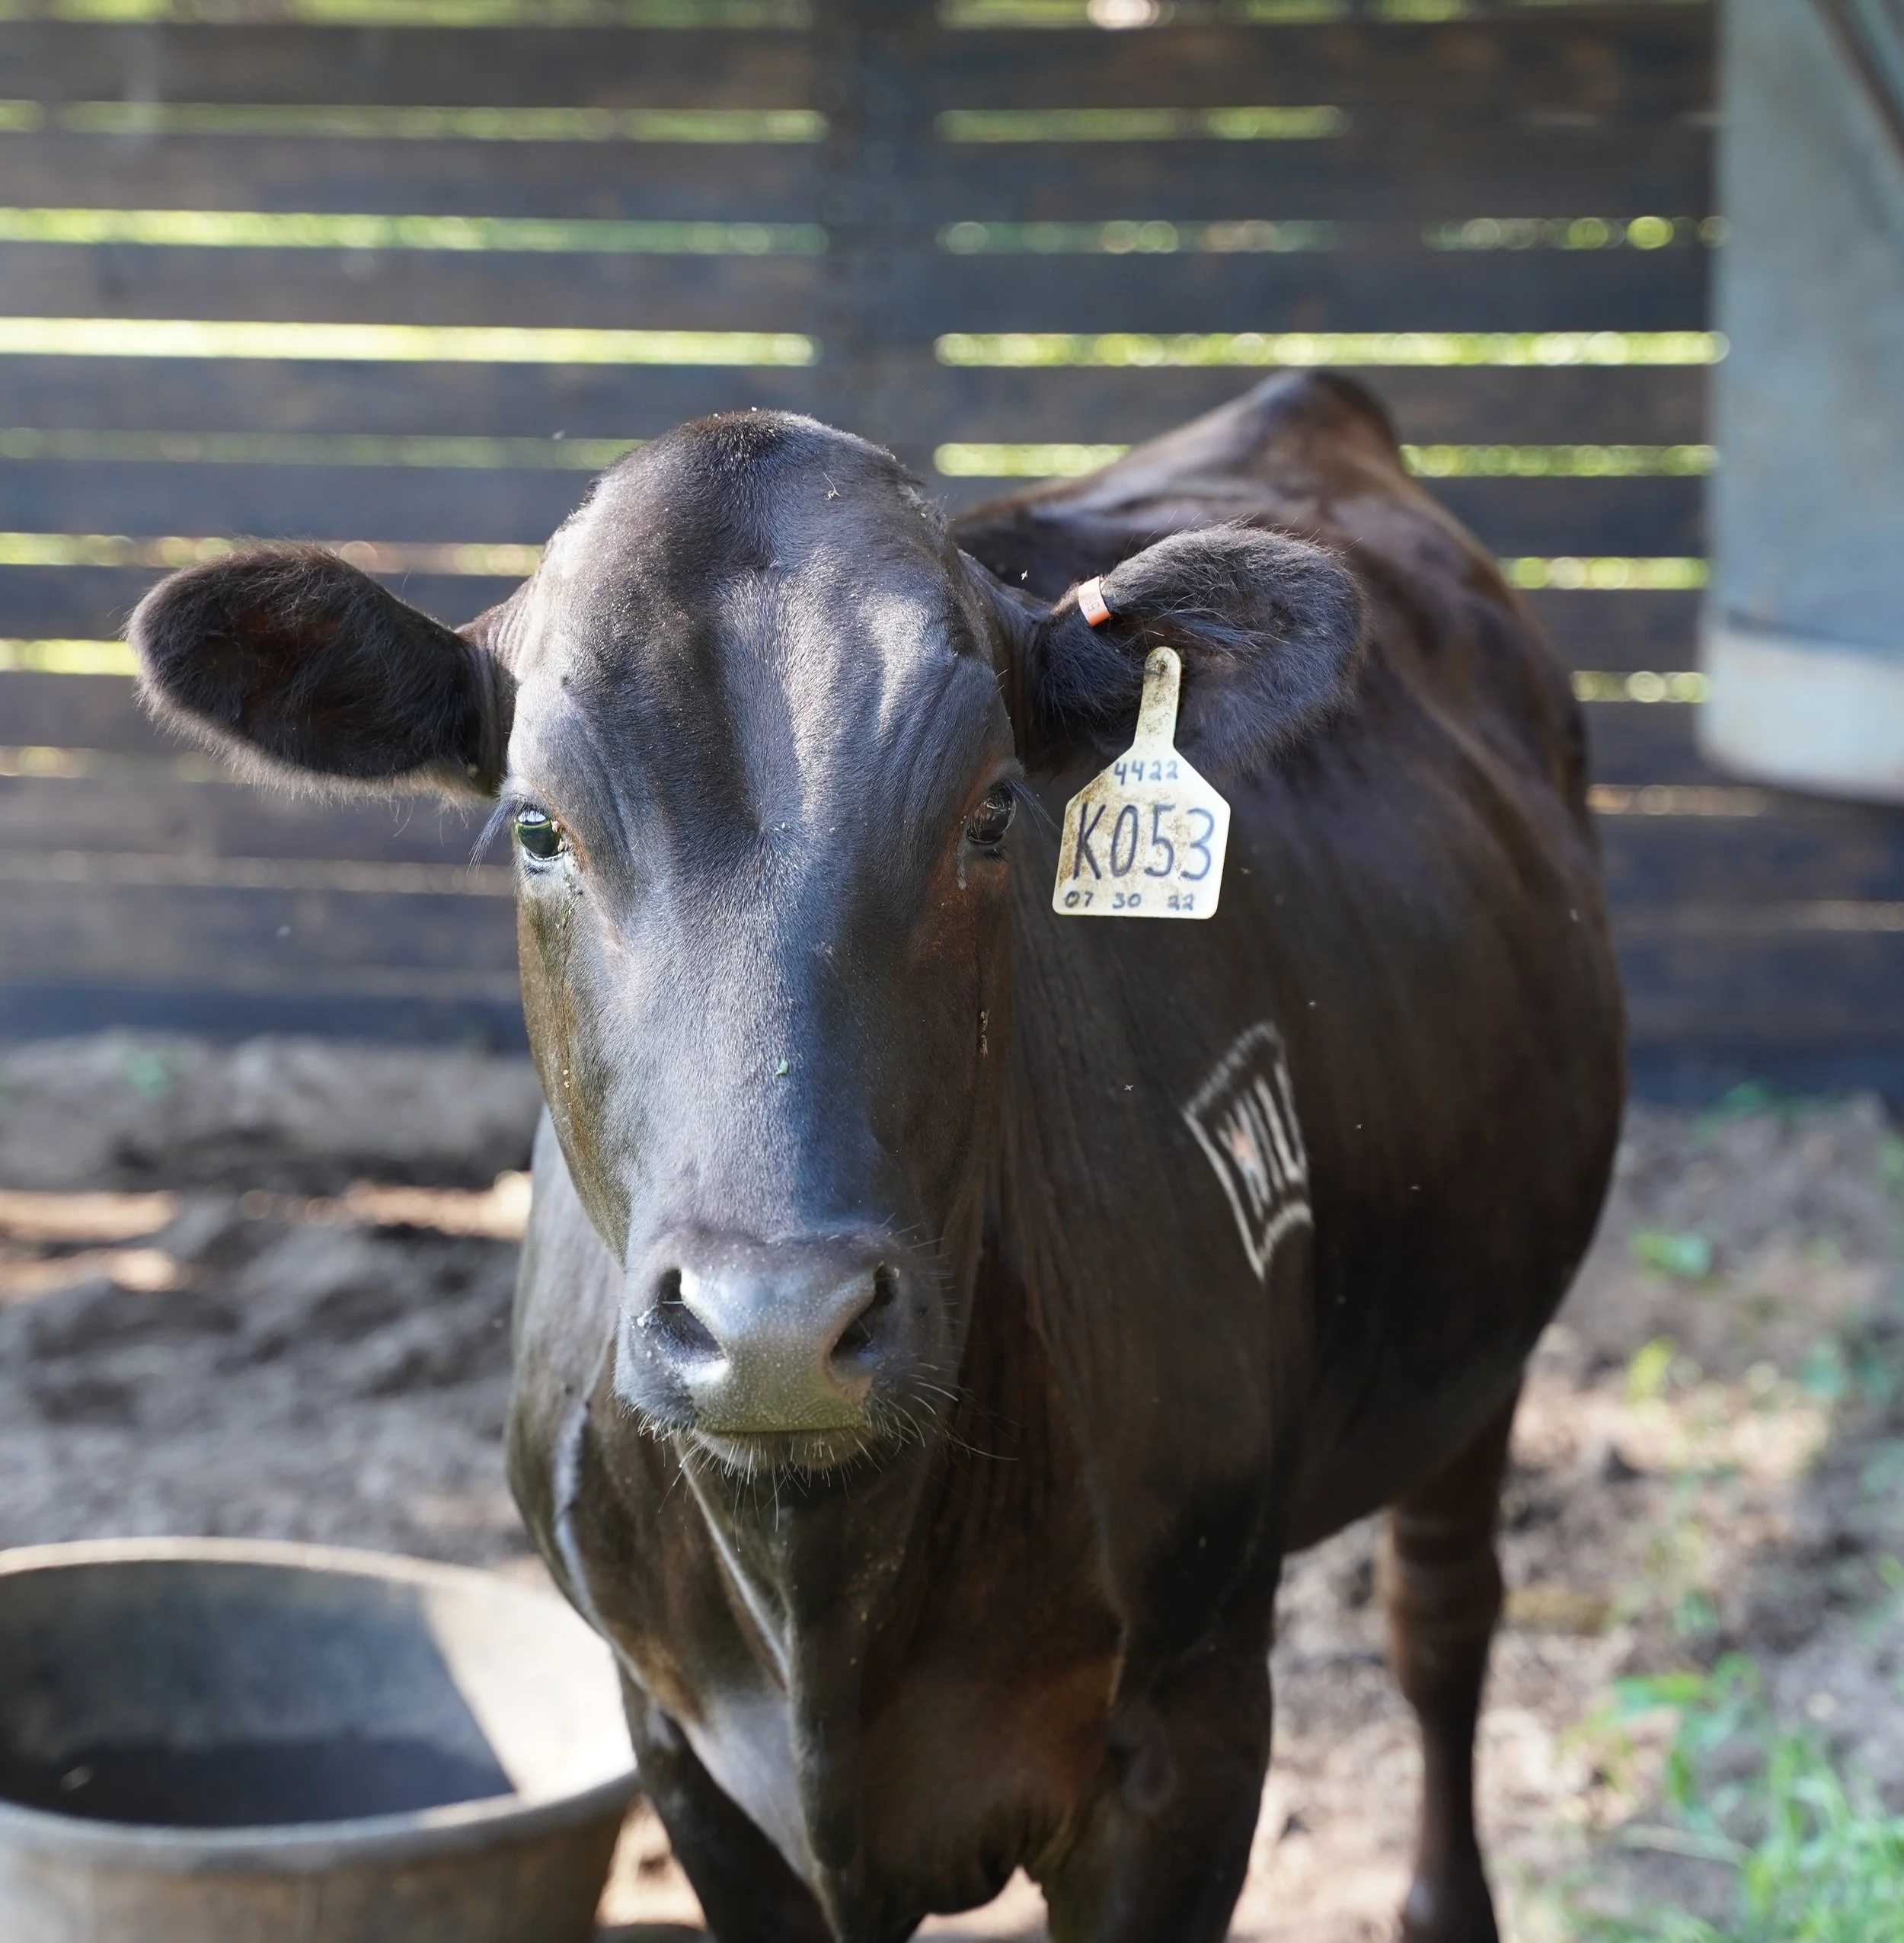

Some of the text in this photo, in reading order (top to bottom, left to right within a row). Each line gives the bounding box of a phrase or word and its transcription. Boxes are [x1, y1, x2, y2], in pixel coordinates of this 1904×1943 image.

[1113, 760, 1178, 785] 4422
[1072, 802, 1215, 880] K053
[1065, 890, 1196, 912] 07 30 22
